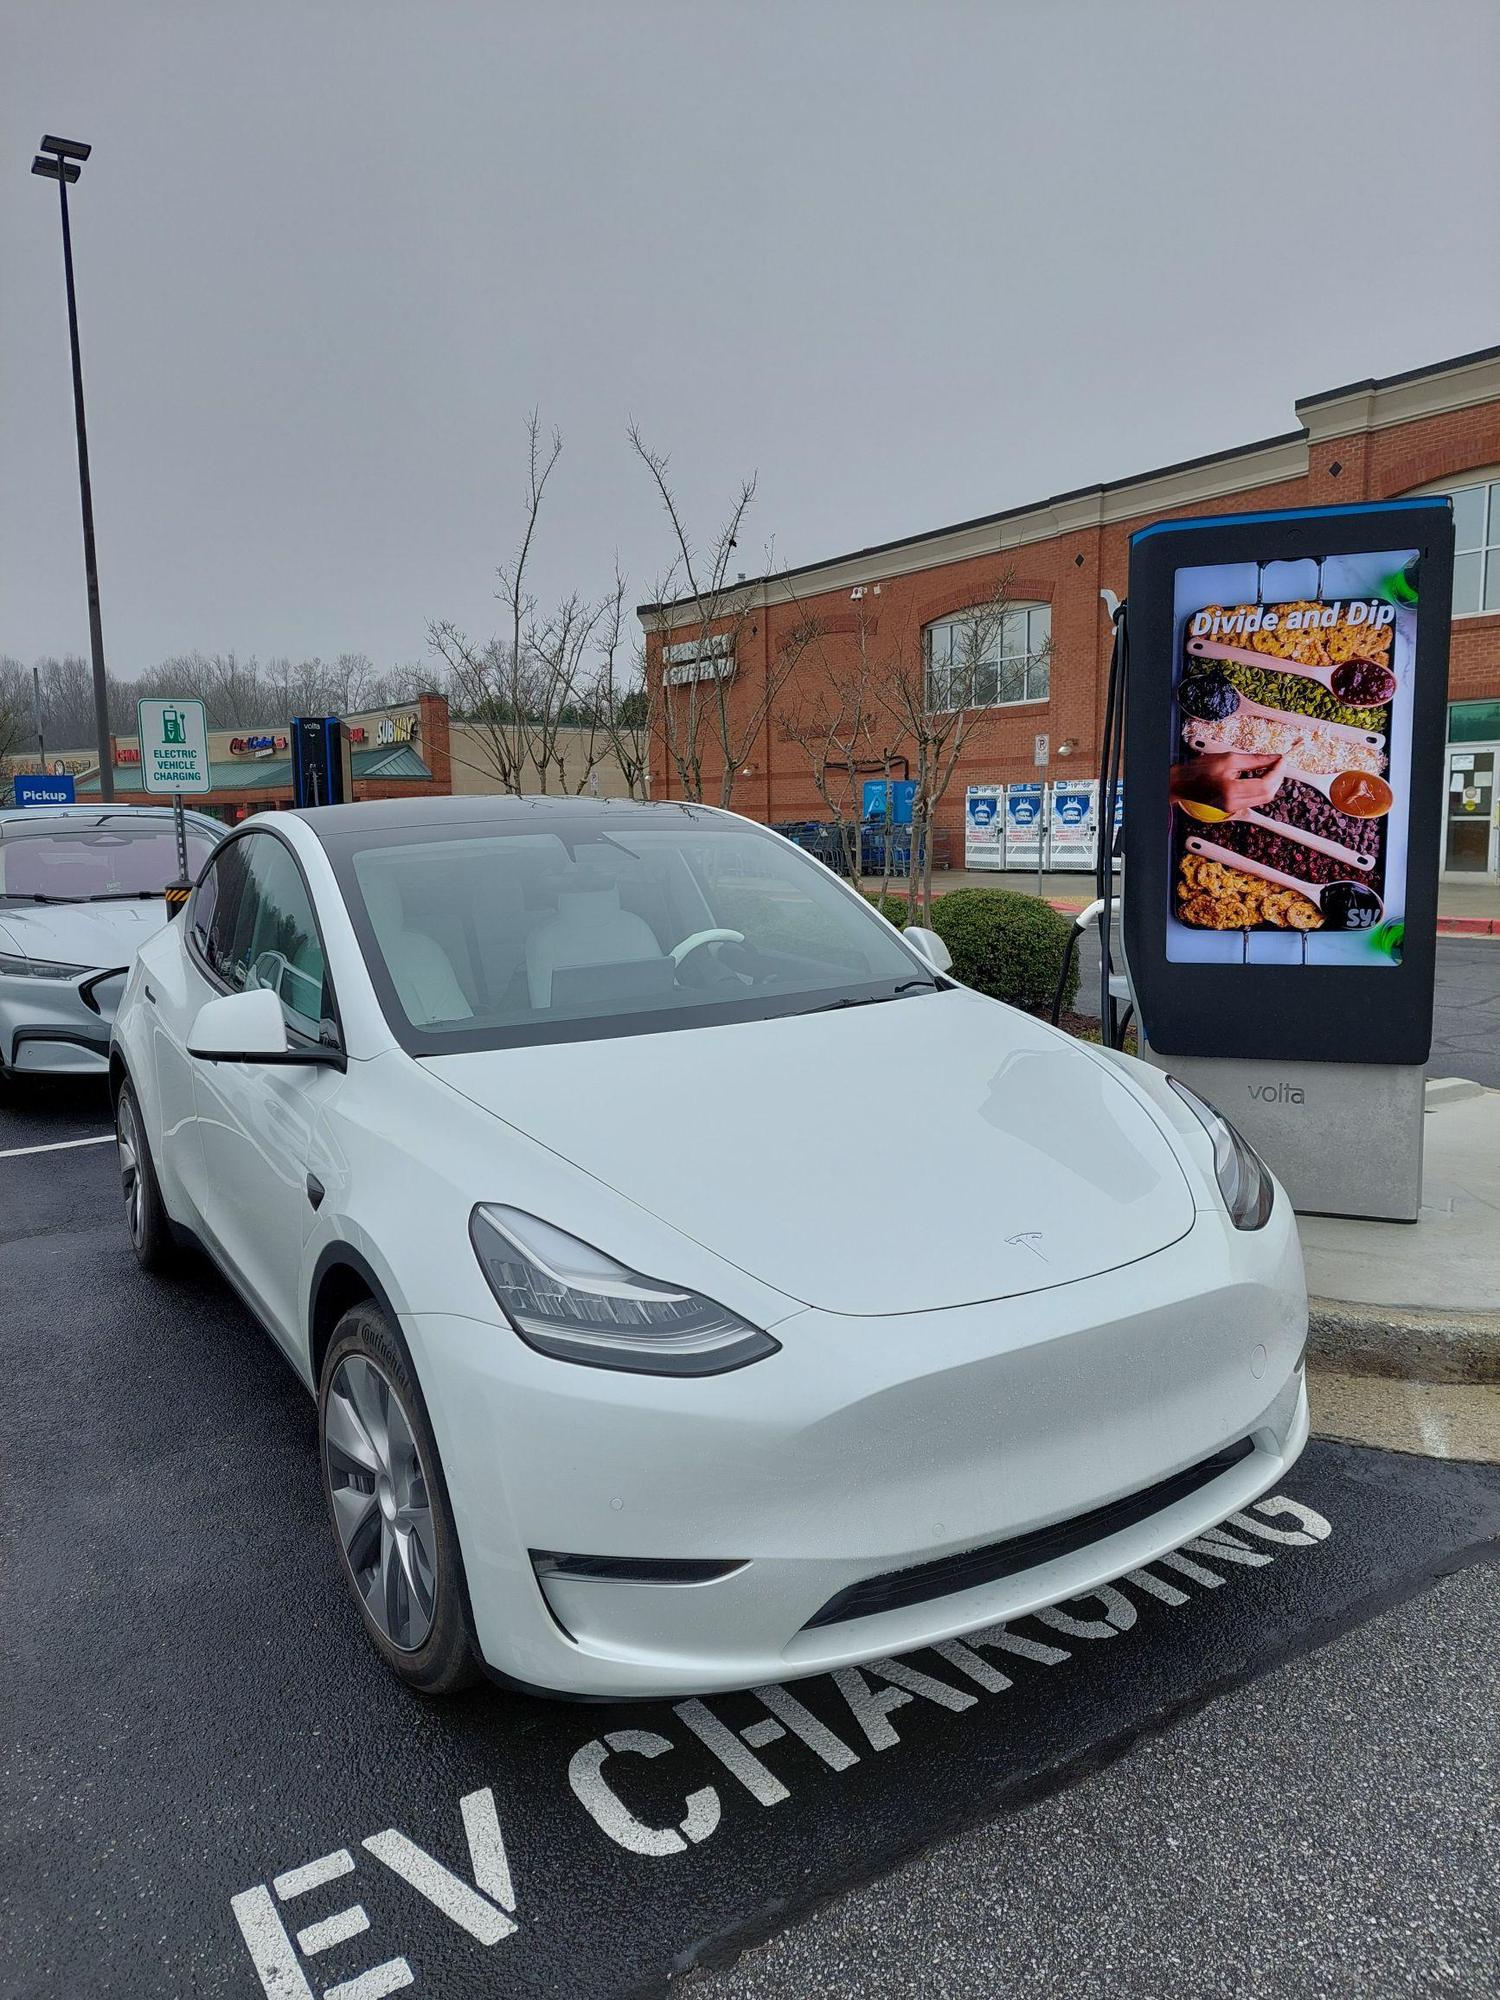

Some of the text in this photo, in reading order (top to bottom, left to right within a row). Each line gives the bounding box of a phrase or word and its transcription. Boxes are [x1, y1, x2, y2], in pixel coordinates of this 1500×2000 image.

[1192, 600, 1395, 636] Divide and Dip
[376, 714, 416, 744] SUBWAY
[153, 749, 197, 758] ELECTRIC
[157, 761, 196, 770] VEHICLE
[153, 772, 201, 781] CHARGING
[22, 790, 67, 802] Pickup
[1247, 1082, 1305, 1105] volta
[230, 1787, 518, 2000] EV
